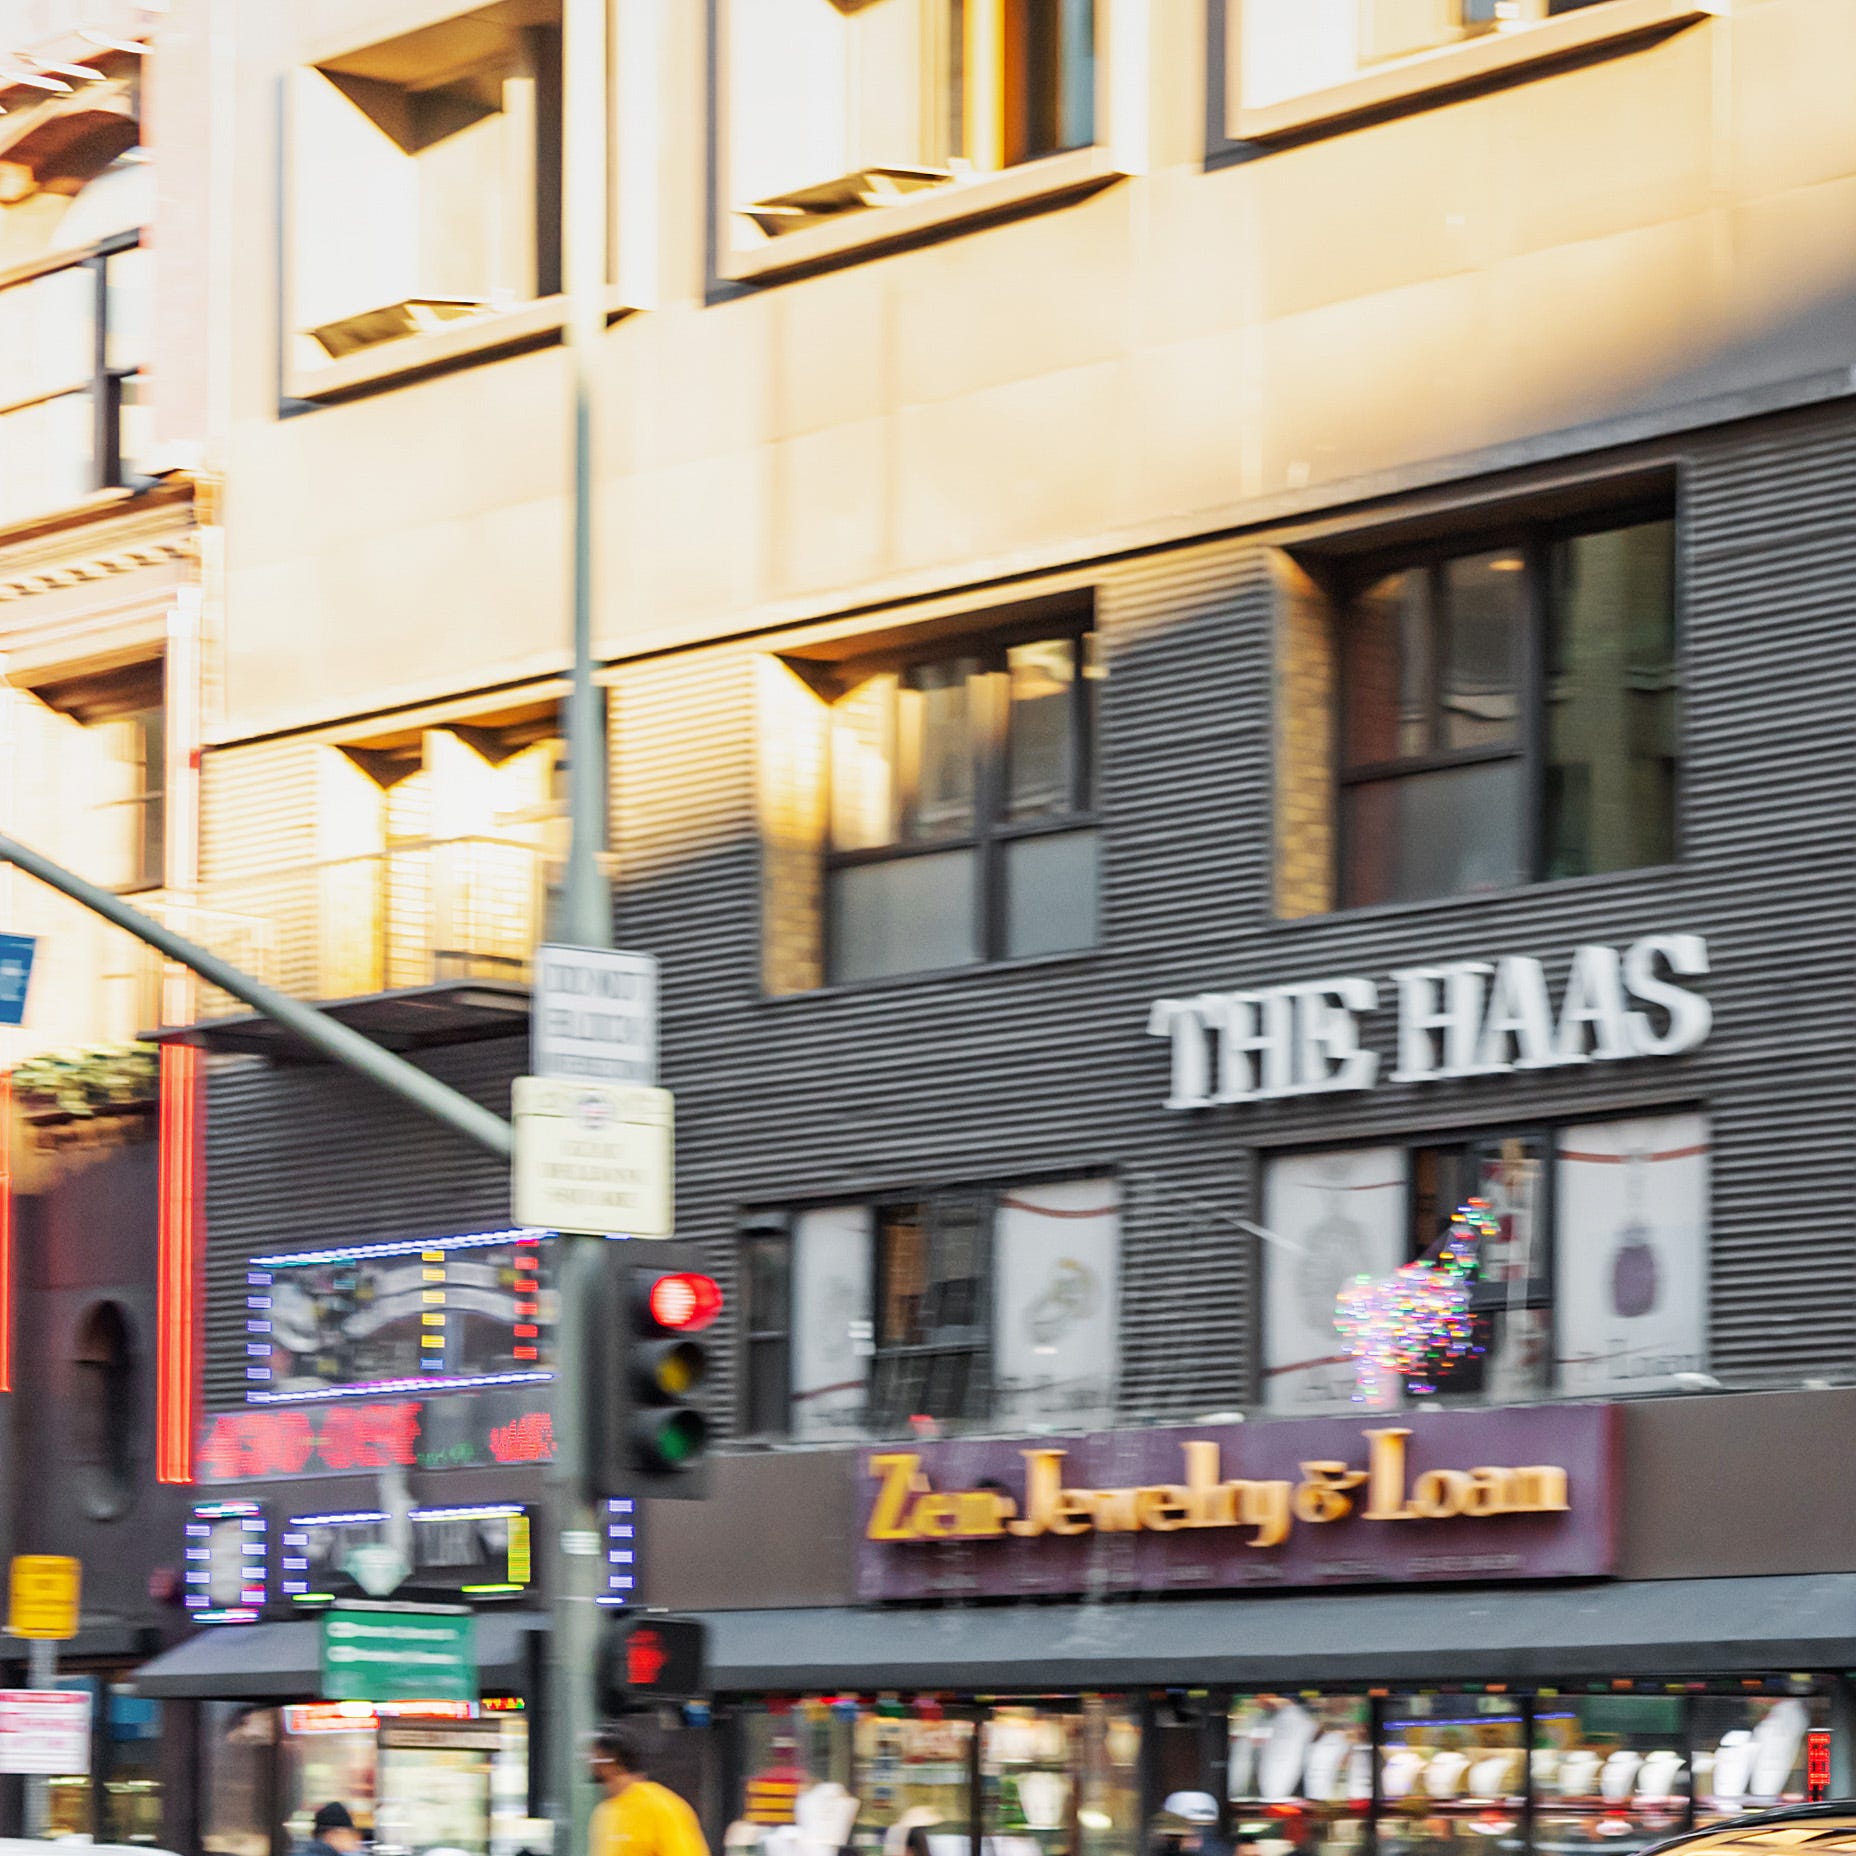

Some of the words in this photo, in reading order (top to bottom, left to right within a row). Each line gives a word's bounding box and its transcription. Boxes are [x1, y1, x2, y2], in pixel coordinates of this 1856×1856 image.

[1146, 977, 1380, 1110] THE
[1389, 934, 1713, 1084] HAAS
[1006, 1441, 1293, 1547] Jewelry
[1291, 1459, 1369, 1523] &
[1360, 1427, 1572, 1521] Loan
